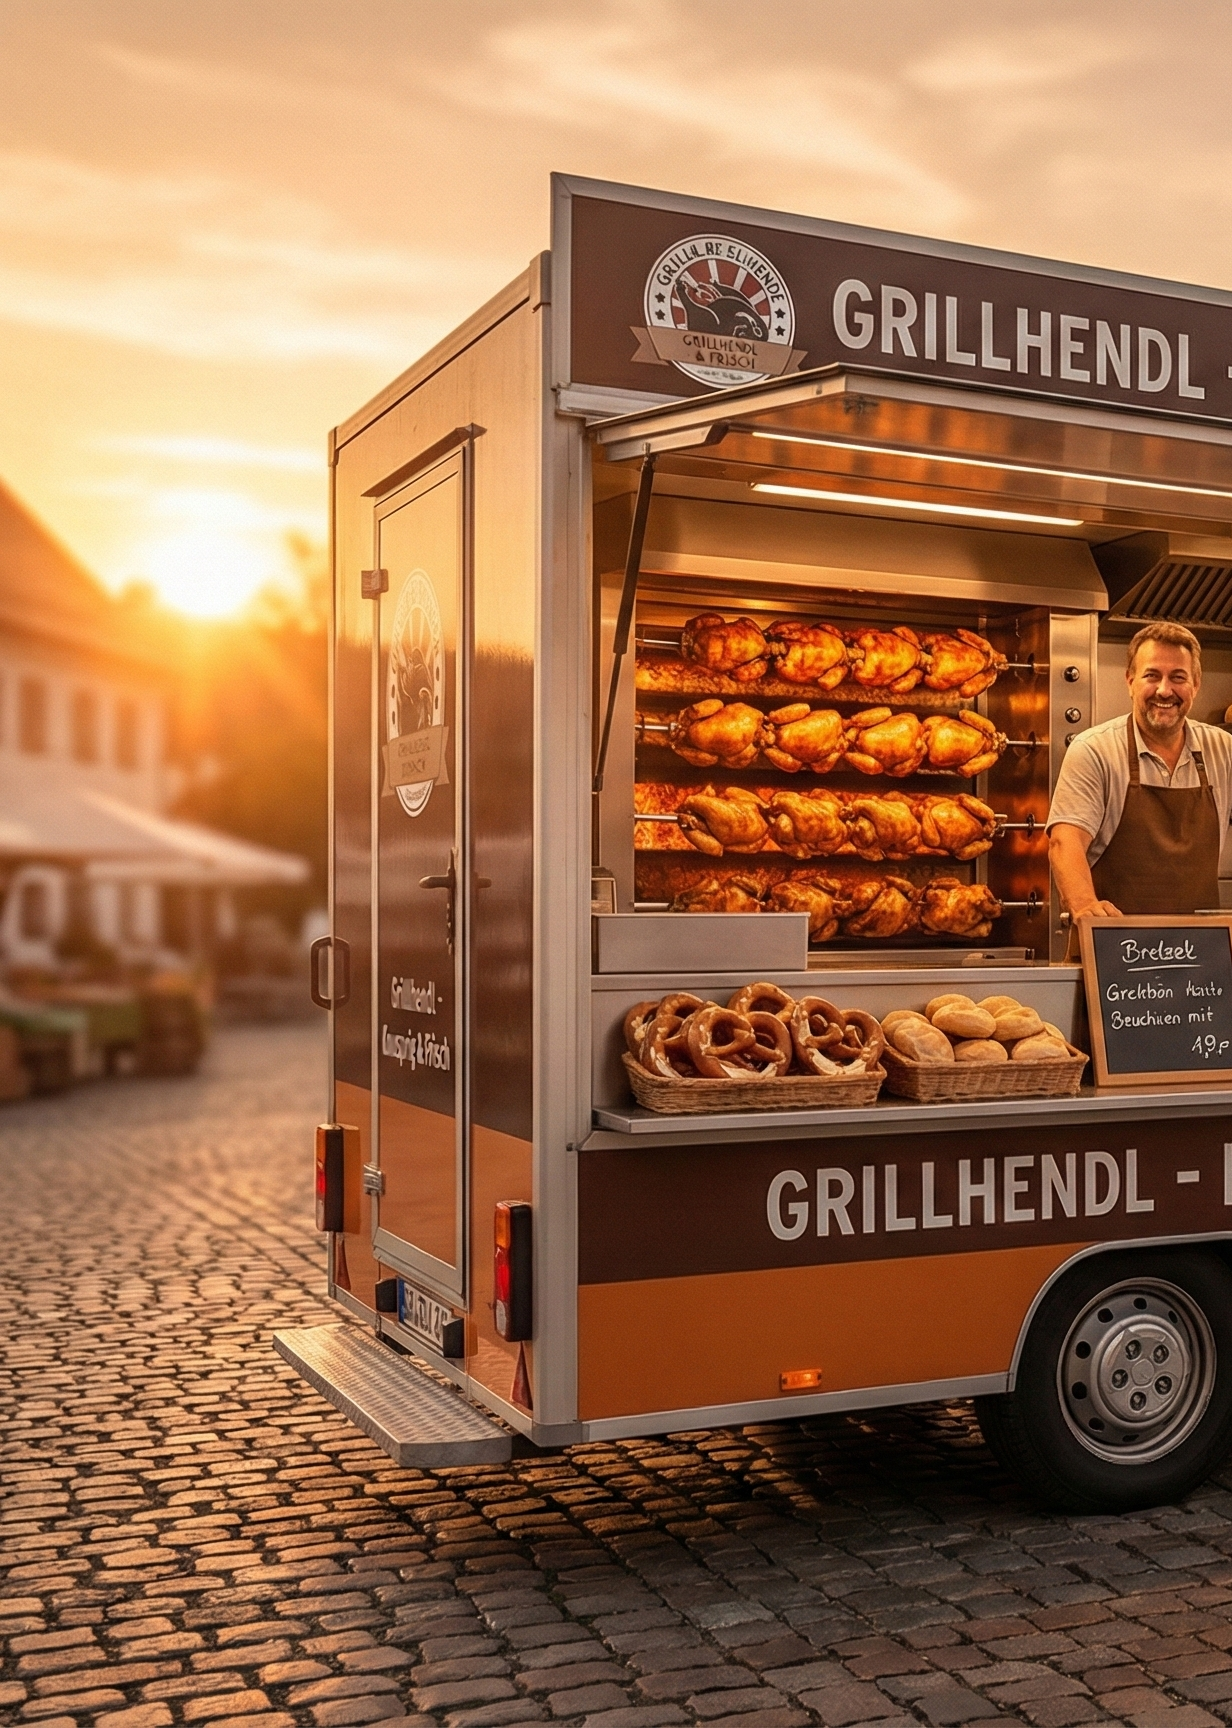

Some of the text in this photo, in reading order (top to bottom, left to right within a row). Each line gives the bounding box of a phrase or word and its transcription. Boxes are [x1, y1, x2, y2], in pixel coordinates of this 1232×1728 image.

[832, 278, 1206, 402] GRILLHENDL
[1188, 1006, 1214, 1023] mit
[766, 1148, 1155, 1241] GRILLHENDL
[1176, 1170, 1200, 1184] -
